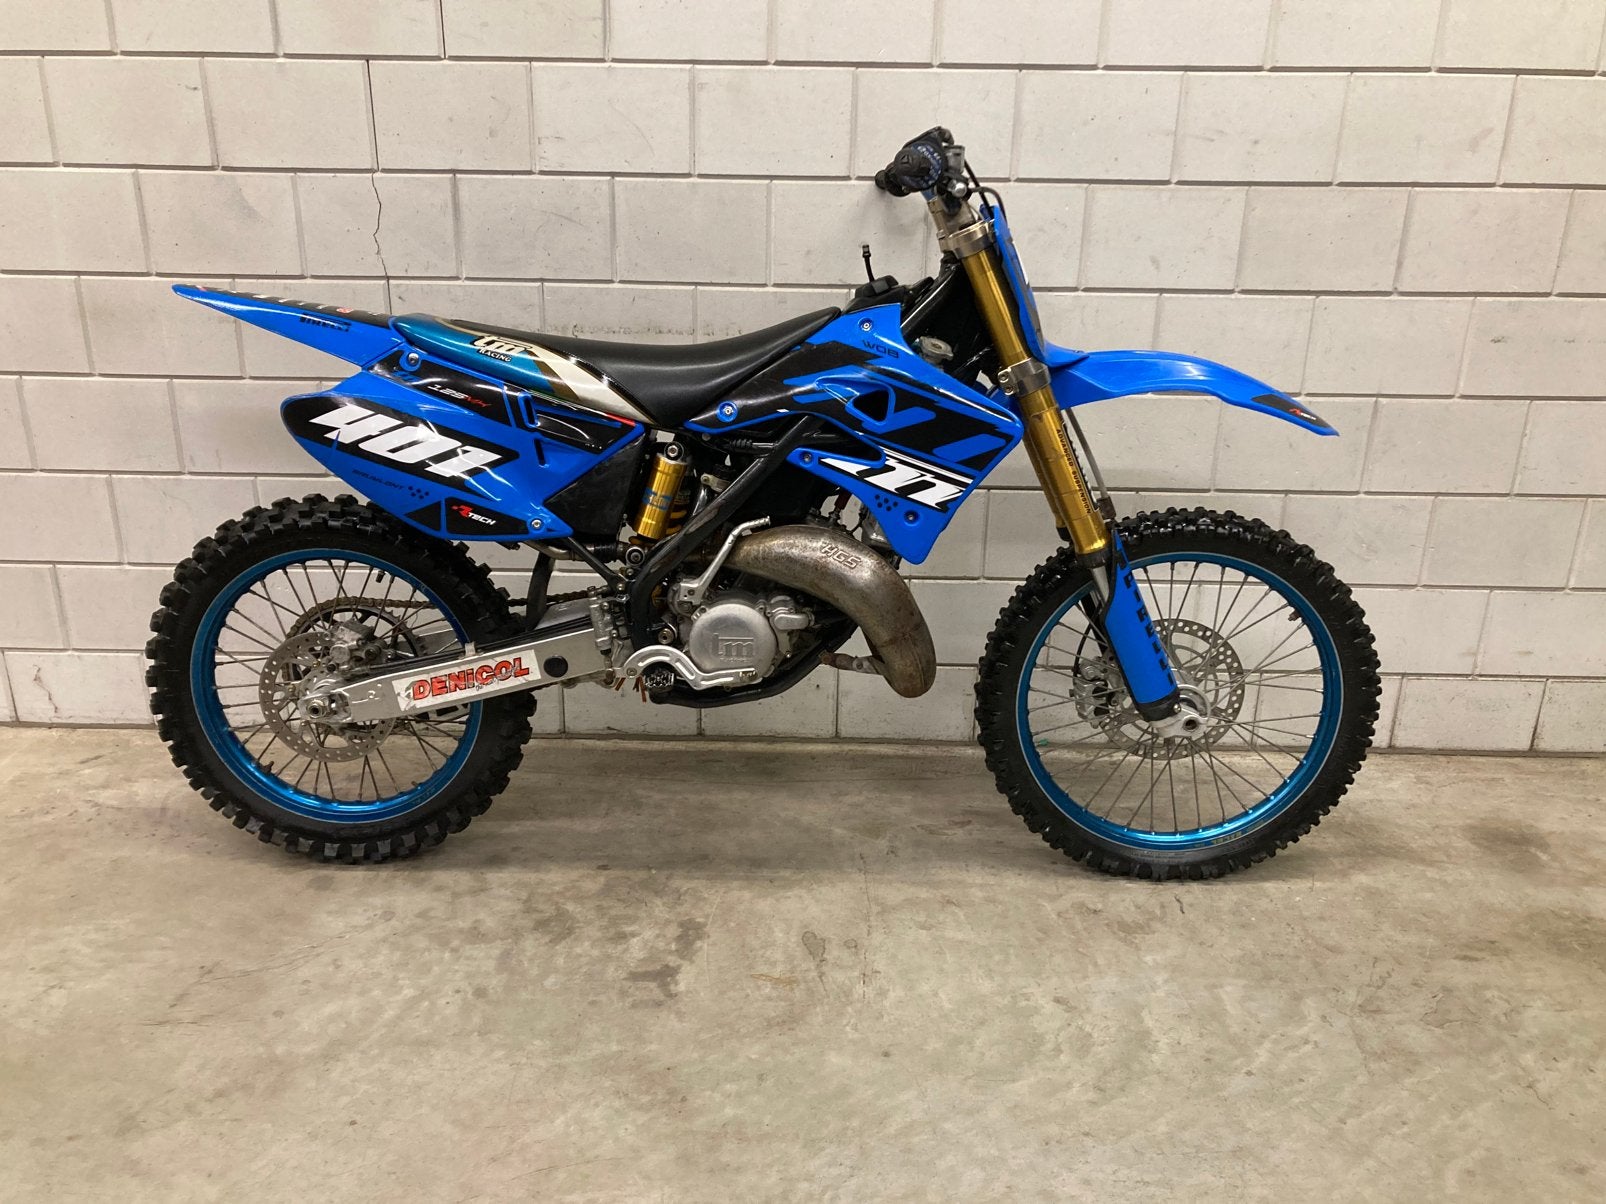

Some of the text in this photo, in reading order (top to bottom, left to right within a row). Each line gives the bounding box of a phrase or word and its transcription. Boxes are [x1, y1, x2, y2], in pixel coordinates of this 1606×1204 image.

[478, 348, 512, 362] RACING
[1056, 428, 1074, 467] ADVANCED
[1071, 469, 1092, 514] SUSPENSION
[821, 543, 862, 570] HGS
